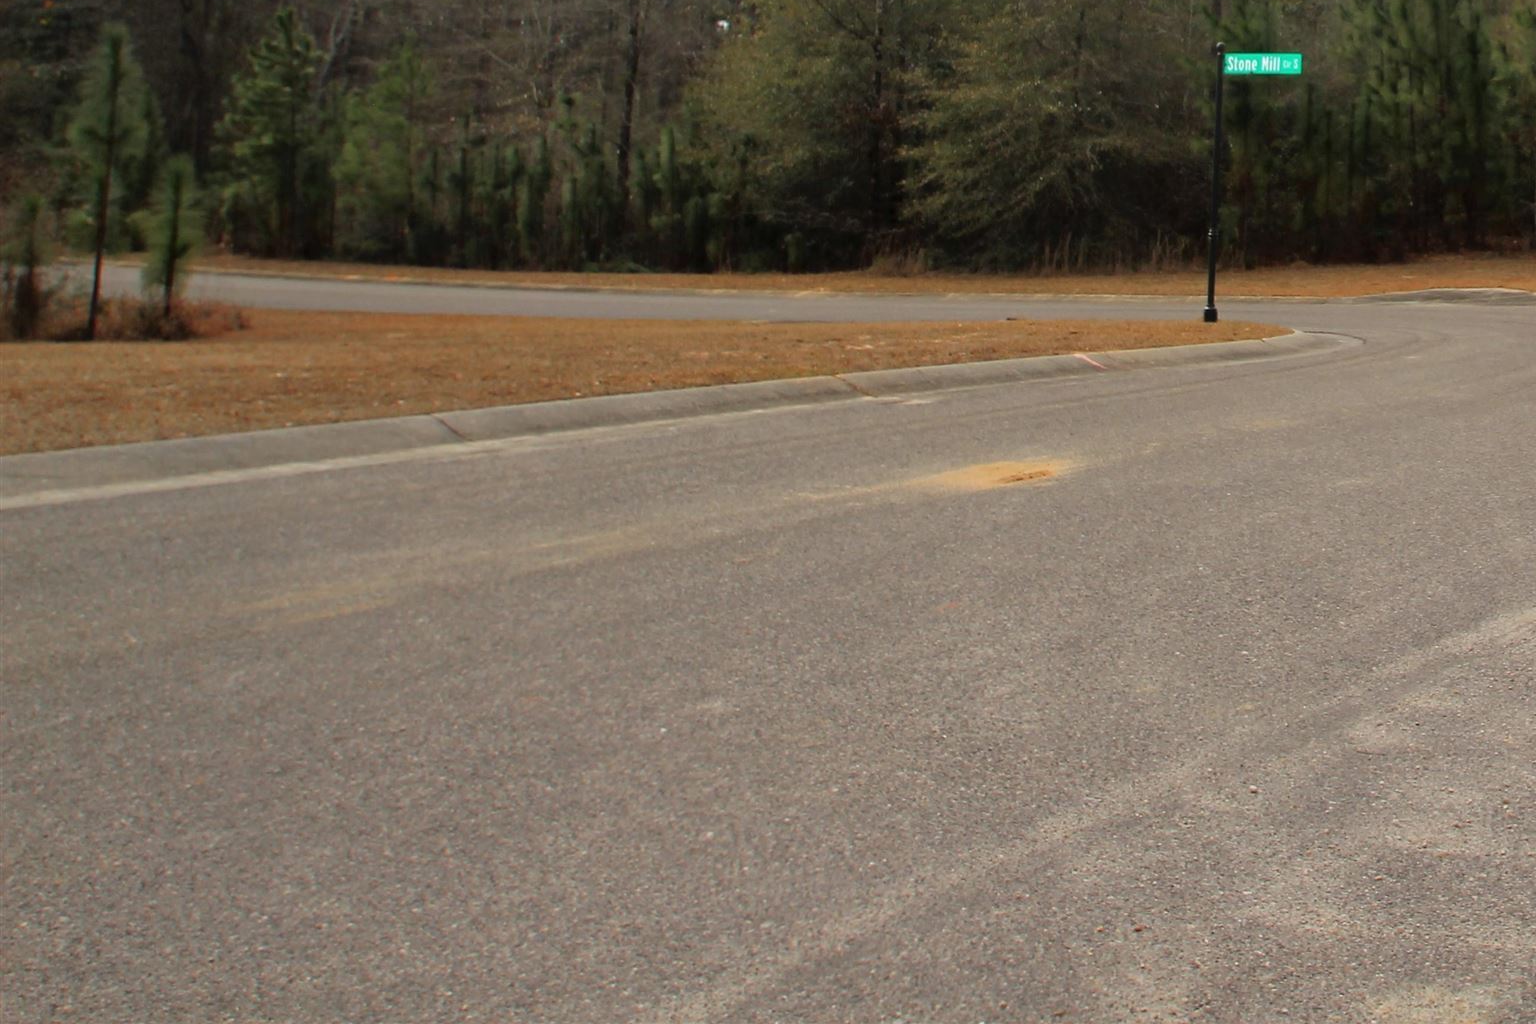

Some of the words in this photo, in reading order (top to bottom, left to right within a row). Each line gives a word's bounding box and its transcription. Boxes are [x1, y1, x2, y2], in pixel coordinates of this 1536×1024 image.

[1227, 56, 1258, 71] Stone
[1261, 56, 1281, 71] Mill
[1293, 58, 1299, 70] S
